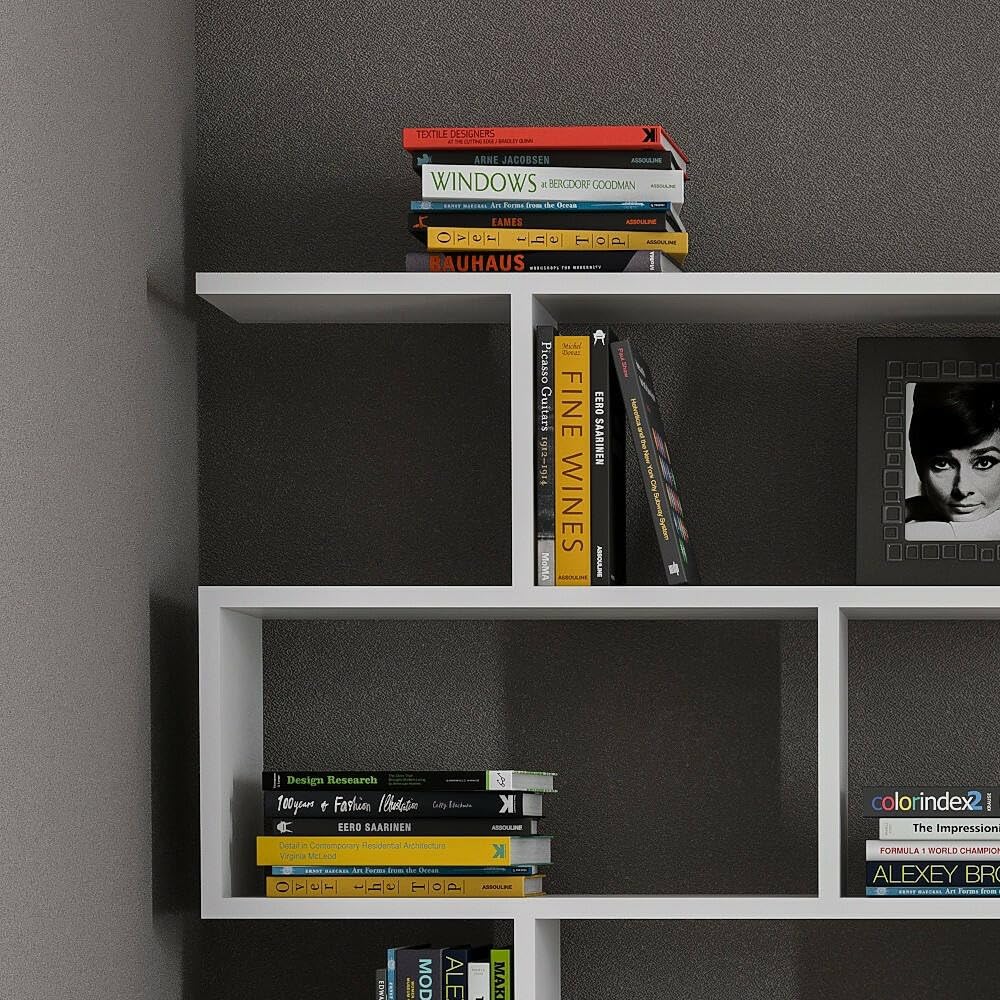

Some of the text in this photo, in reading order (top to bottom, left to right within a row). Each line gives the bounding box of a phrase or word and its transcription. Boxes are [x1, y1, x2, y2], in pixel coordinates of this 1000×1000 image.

[417, 130, 495, 139] TEXTILE DESIGNERS
[474, 156, 550, 165] ARNE JACOBSEN
[430, 171, 537, 193] WINDOWS
[549, 179, 590, 189] BERGDORF
[592, 179, 636, 190] GOODMAN
[491, 218, 523, 227] EAMES
[436, 232, 496, 243] Over
[517, 236, 558, 244] the
[429, 254, 525, 272] BAUHAUS
[541, 342, 552, 384] Picasso
[541, 387, 552, 432] Guitars
[594, 392, 604, 465] EERO SAARINEN
[562, 372, 584, 552] FINE WINES
[541, 552, 550, 581] MoMA
[286, 776, 324, 786] Design
[326, 776, 378, 784] Research
[334, 796, 371, 813] Fashion
[872, 790, 983, 811] colorindex2
[338, 822, 412, 832] EERO SAARINEN
[912, 824, 932, 832] The
[310, 842, 360, 853] Contemporary
[872, 864, 958, 884] ALEXEY
[276, 881, 334, 892] Over
[354, 882, 396, 891] the
